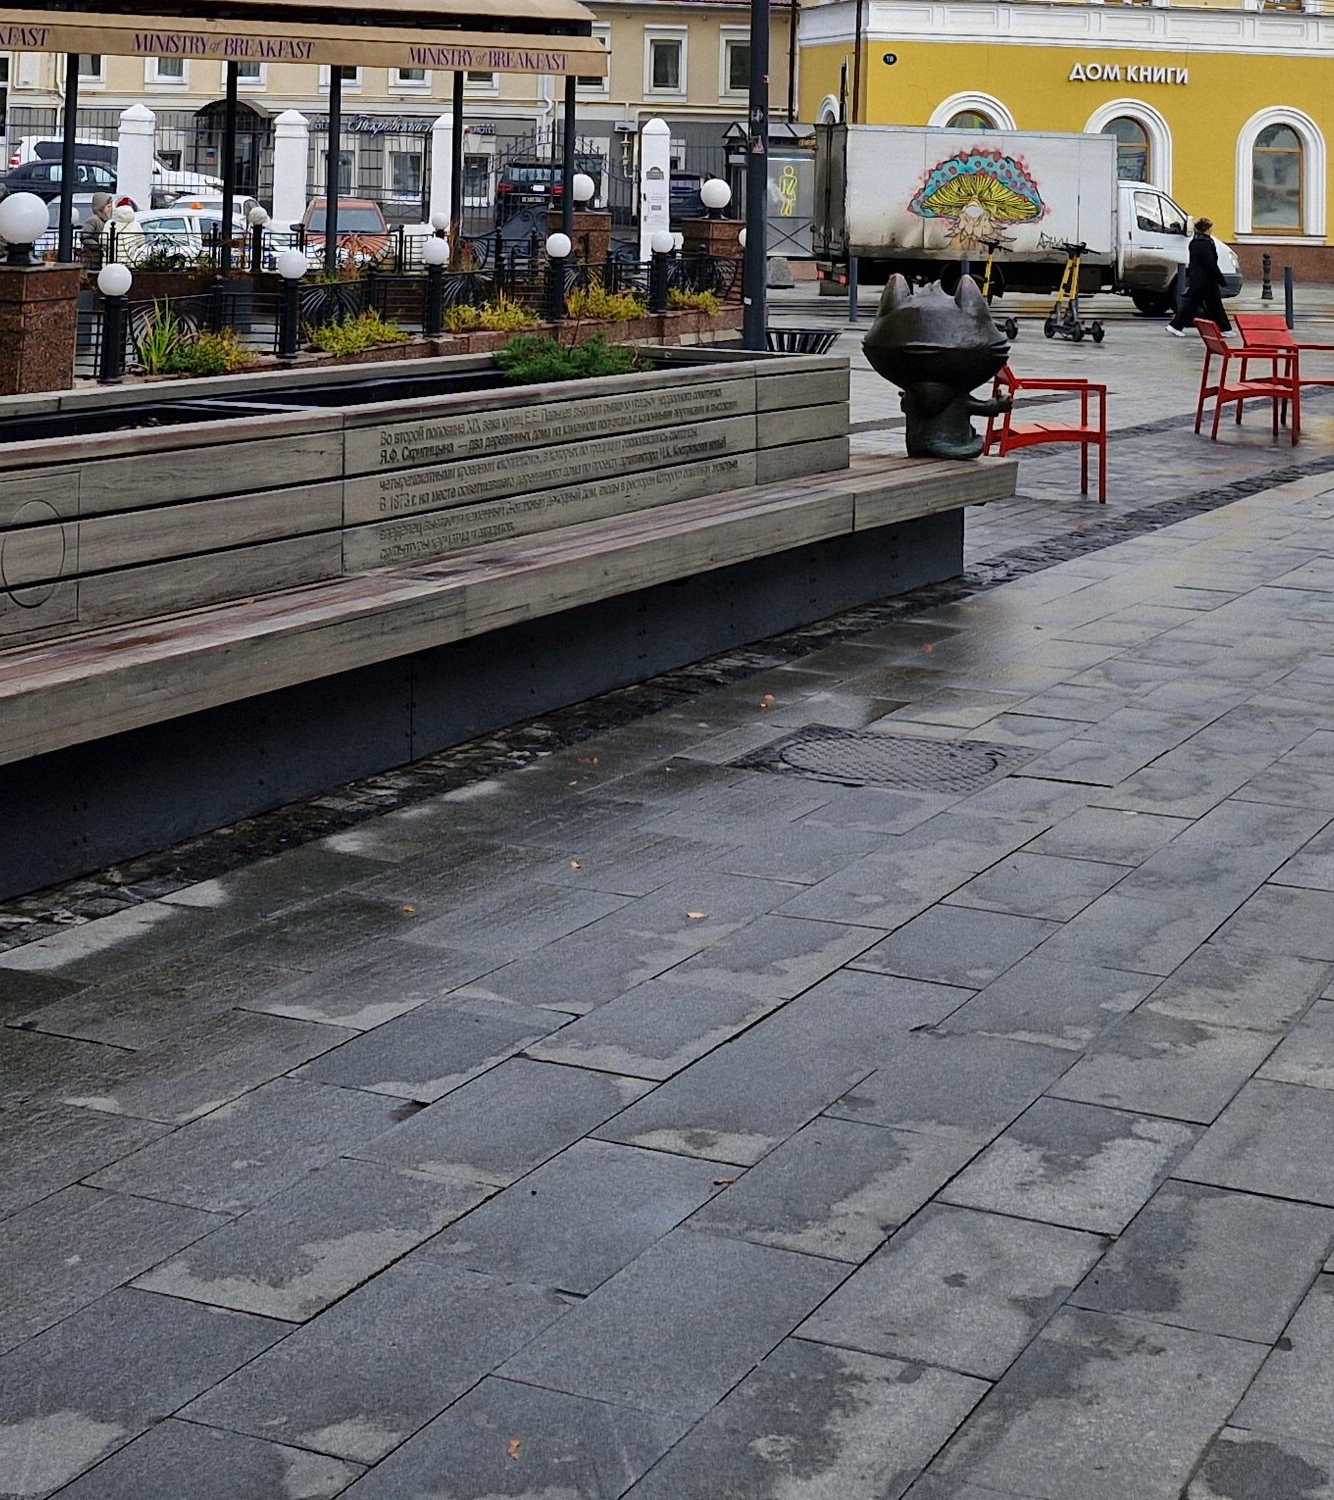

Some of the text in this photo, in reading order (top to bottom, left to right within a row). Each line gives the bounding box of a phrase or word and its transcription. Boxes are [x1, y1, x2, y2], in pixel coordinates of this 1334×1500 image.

[132, 33, 210, 54] MINISTRY
[224, 37, 316, 60] BREAKFAST
[408, 46, 475, 66] MINISTRY
[489, 50, 569, 71] BREAKFAST
[1069, 62, 1189, 85] ДОМ КНИГИ
[379, 431, 393, 446] Во
[393, 427, 424, 446] второй
[424, 424, 465, 439] половине
[465, 418, 481, 434] XIX
[481, 419, 500, 431] века
[378, 448, 399, 464] Я.Ф.
[467, 439, 484, 452] два
[417, 493, 429, 503] на
